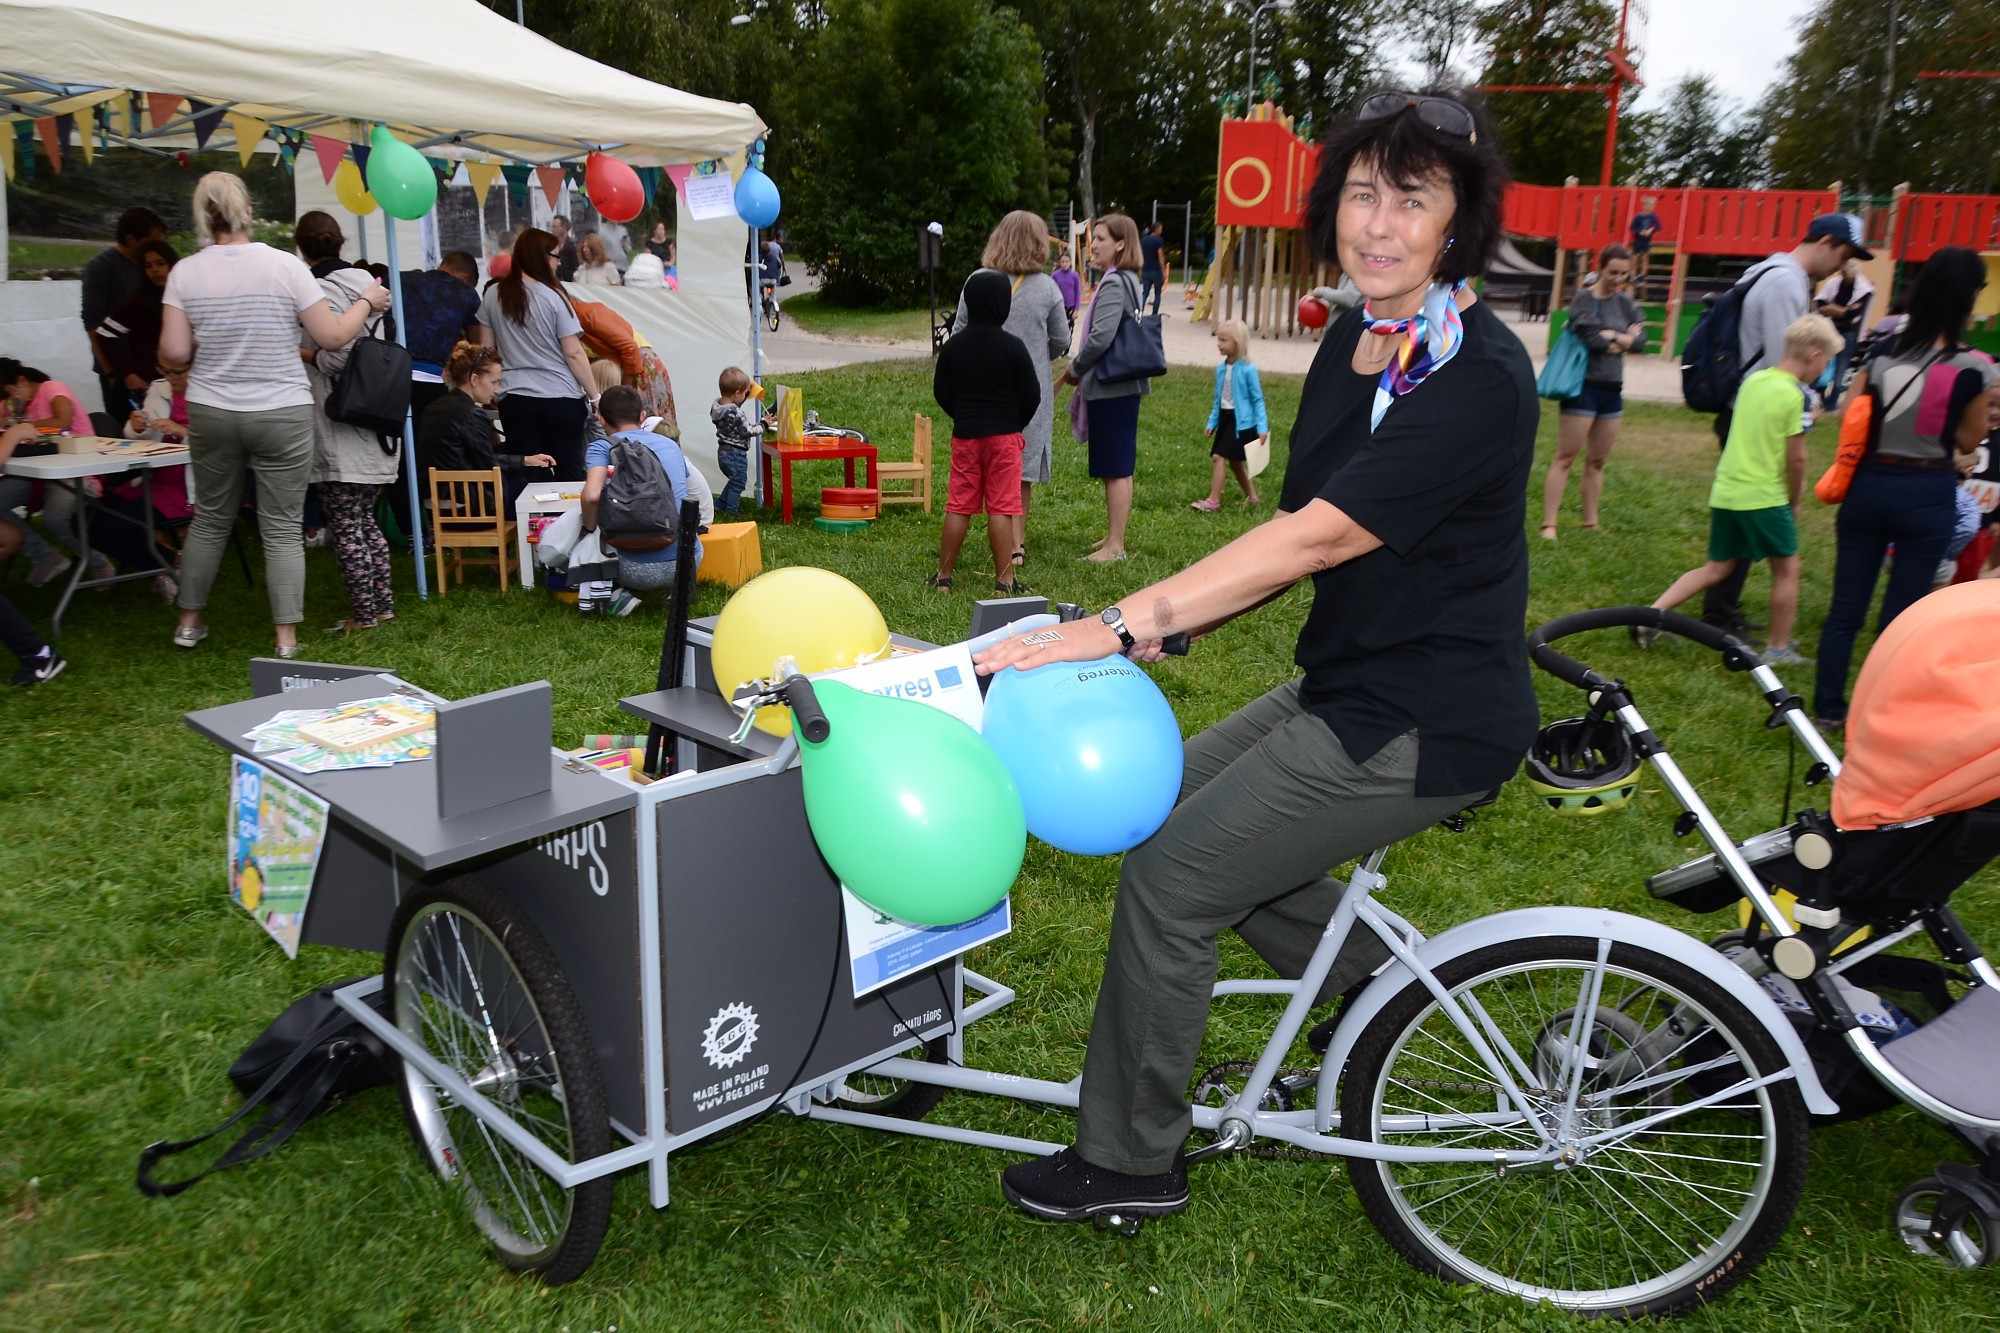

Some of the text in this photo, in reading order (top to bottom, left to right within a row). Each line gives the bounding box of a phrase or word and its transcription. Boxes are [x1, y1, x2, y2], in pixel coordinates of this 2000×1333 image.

[1077, 668, 1137, 682] Interreg
[922, 1008, 942, 1025] TĀRPS
[718, 1023, 746, 1049] RGG
[693, 1064, 770, 1103] MADE IN POLAND
[697, 1078, 765, 1112] WWW.RGG.BIKE
[1695, 1250, 1743, 1291] KENDA
